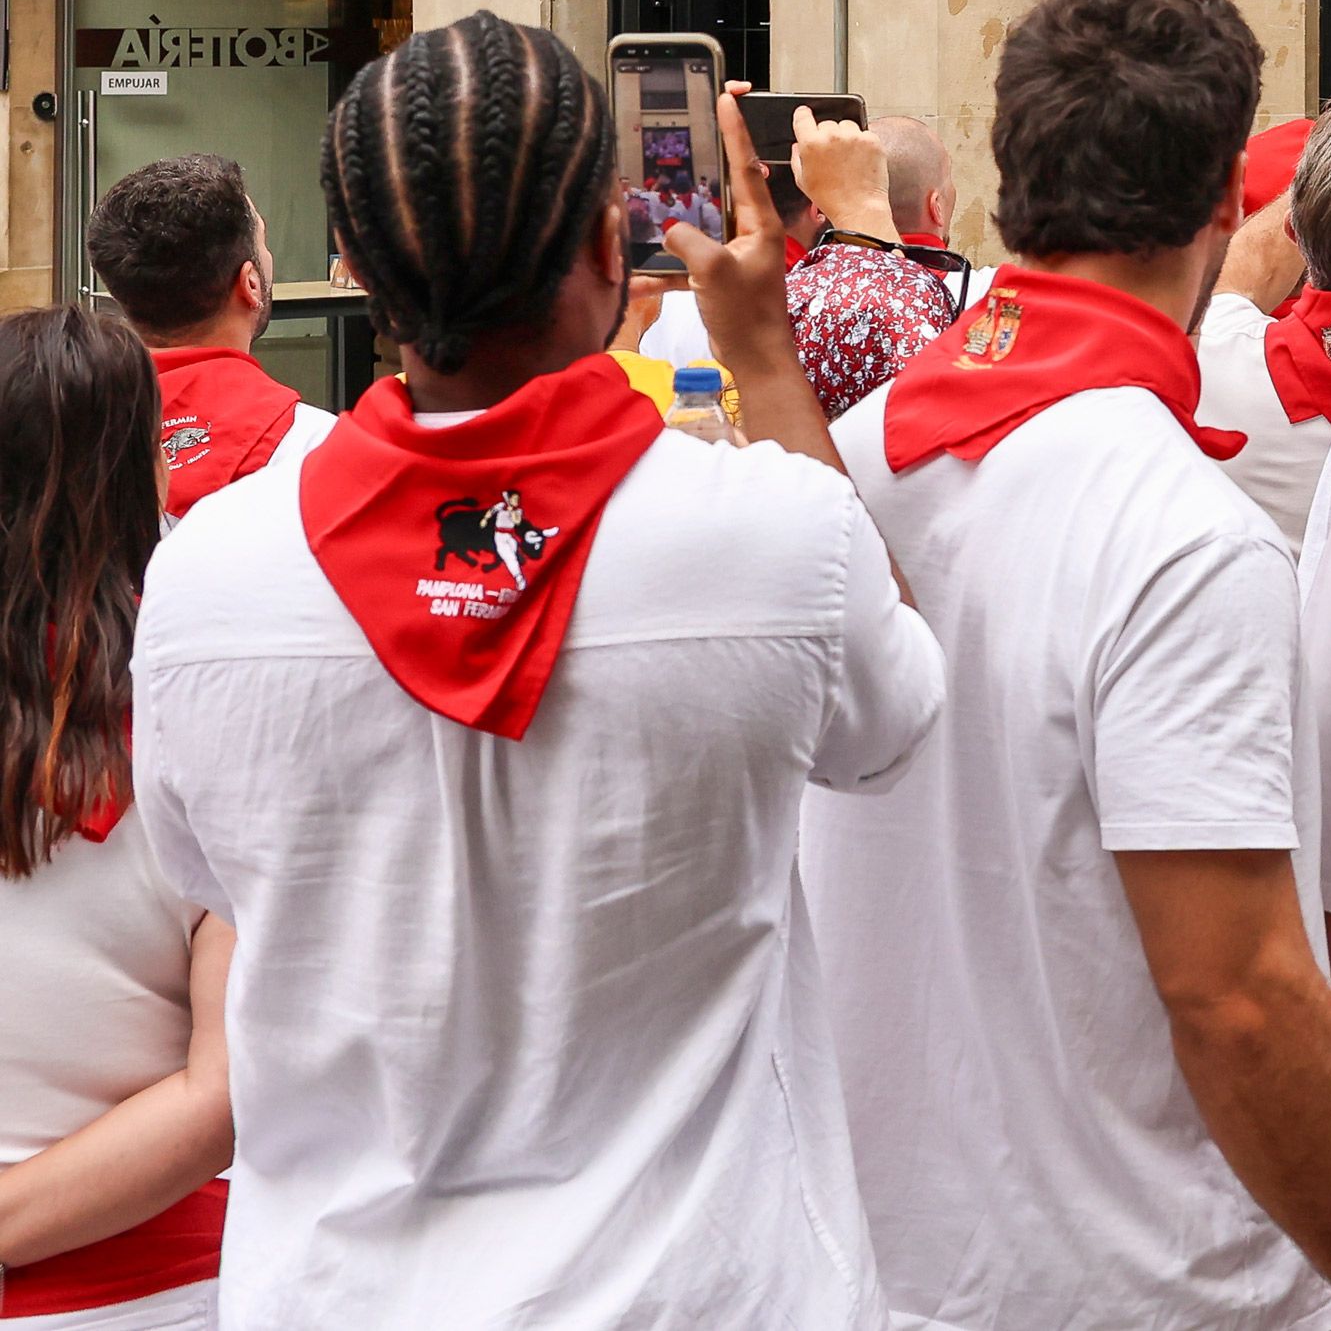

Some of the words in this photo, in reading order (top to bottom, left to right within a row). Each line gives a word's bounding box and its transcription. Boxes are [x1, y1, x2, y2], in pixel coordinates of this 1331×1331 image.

[108, 77, 160, 89] EMPUJAR
[416, 578, 484, 601] PAMPLONA
[430, 598, 460, 617] SAN
